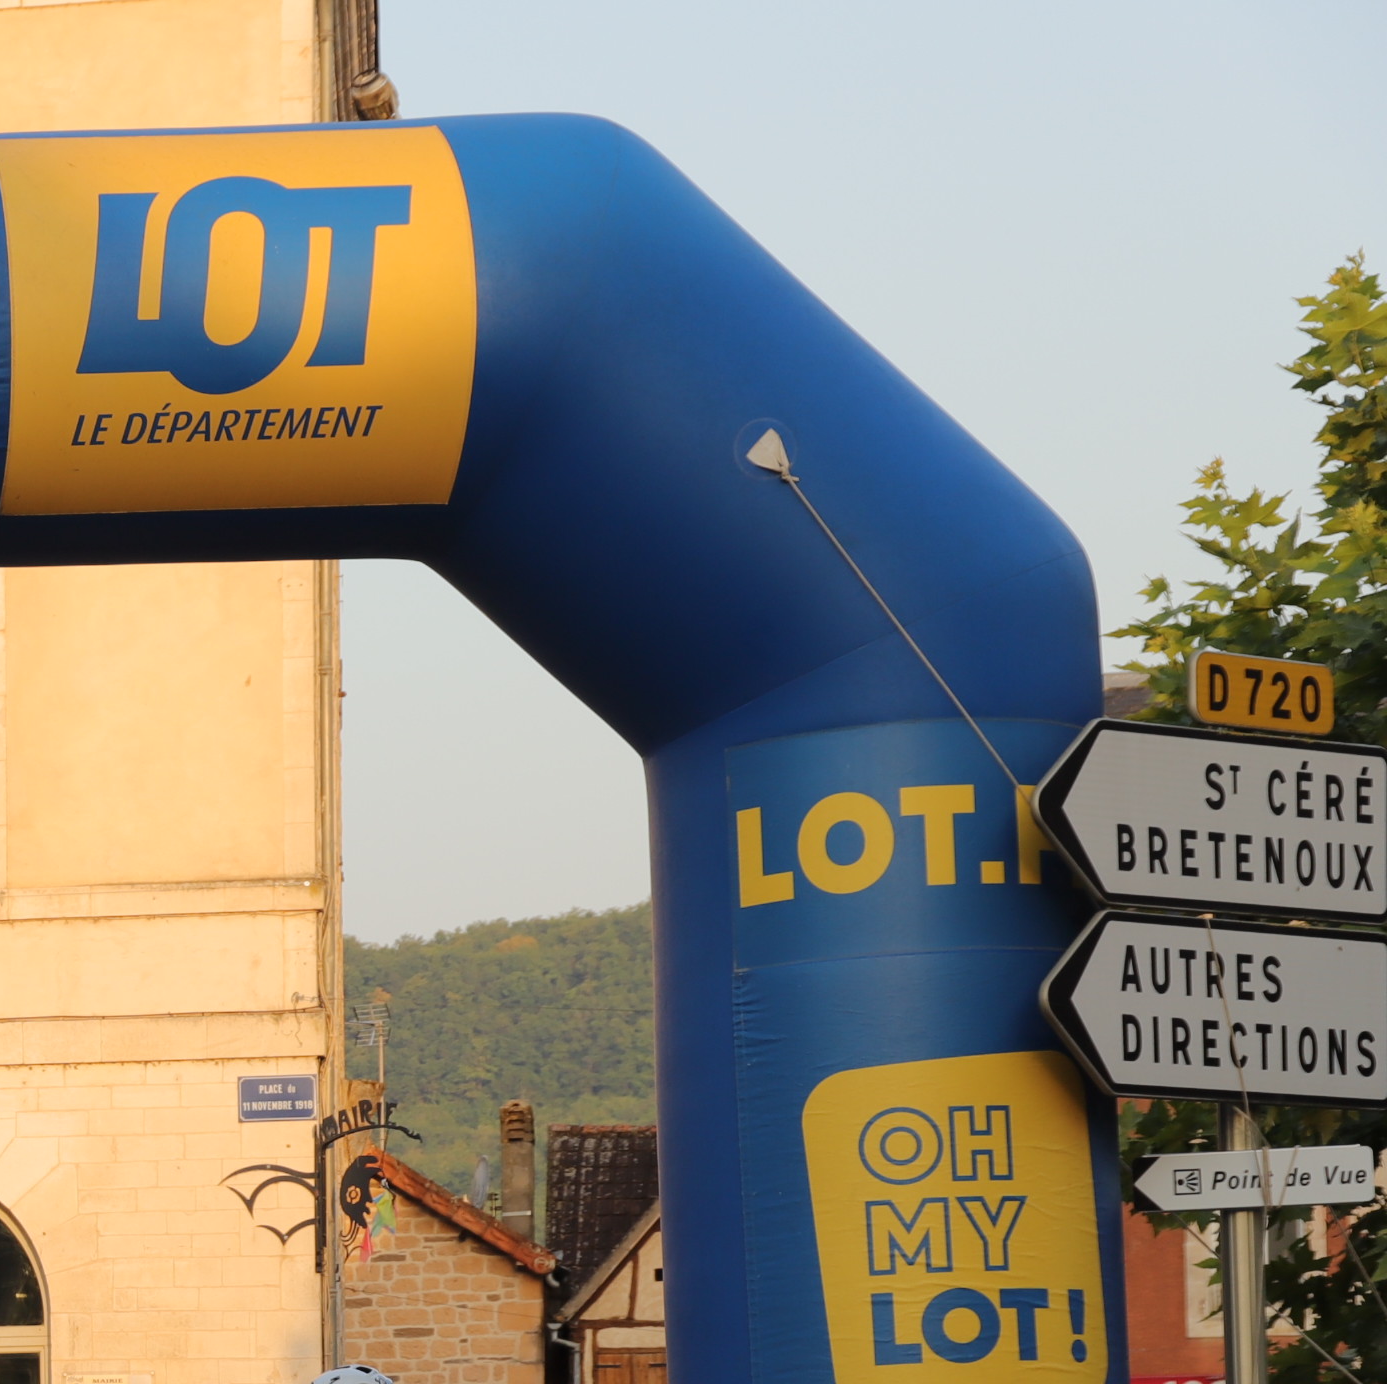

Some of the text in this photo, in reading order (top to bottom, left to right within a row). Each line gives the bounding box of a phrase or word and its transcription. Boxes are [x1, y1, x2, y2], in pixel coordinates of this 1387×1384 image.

[75, 175, 412, 395] LOT
[71, 402, 384, 446] LE DÉPARTEMENT
[1207, 663, 1322, 723] D 720
[1267, 760, 1376, 825] CÉRÉ
[1116, 823, 1374, 892] BRETENOUX
[1120, 944, 1284, 1003] AUTRES
[1122, 1013, 1377, 1078] DIRECTIONS
[242, 1100, 314, 1111] 11 NOVEMBRE 1918
[258, 1083, 297, 1094] PLACE du
[320, 1099, 399, 1141] MAIRIE
[858, 1104, 1014, 1186] OH
[1210, 1165, 1368, 1191] Point de Vue
[865, 1195, 1027, 1277] MY
